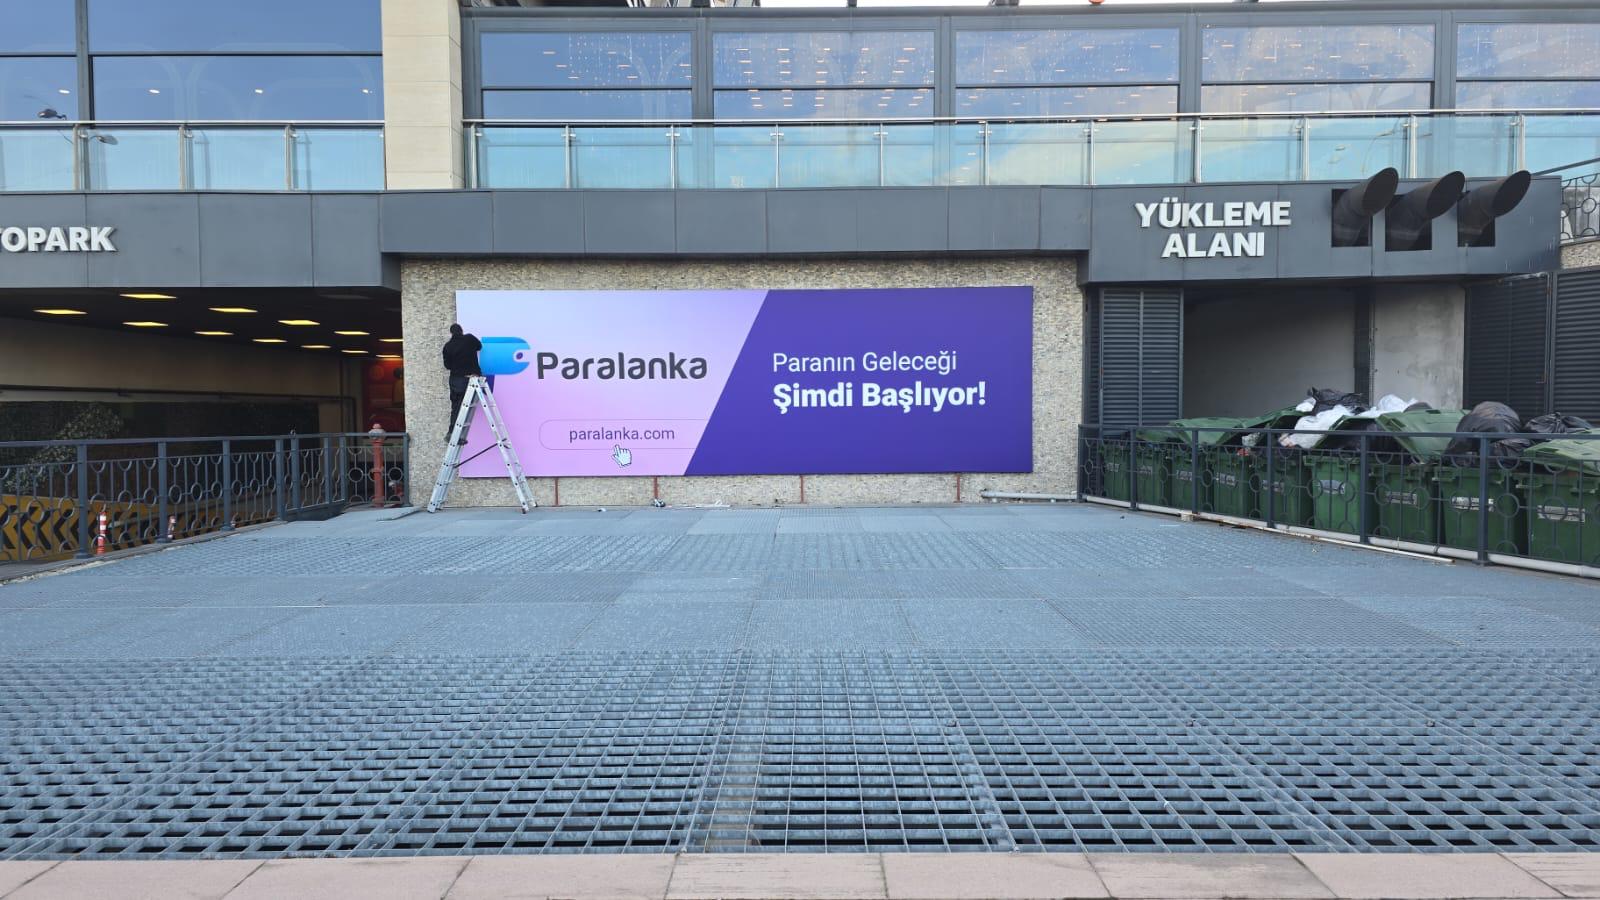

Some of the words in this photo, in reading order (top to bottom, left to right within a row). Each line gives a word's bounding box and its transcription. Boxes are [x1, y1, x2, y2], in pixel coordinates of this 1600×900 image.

[1135, 196, 1292, 228] YÜKLEME
[0, 226, 117, 253] OPARK
[1162, 231, 1265, 258] ALANI
[536, 351, 707, 380] Paralanka
[772, 352, 856, 373] Paranın
[862, 351, 957, 375] Geleceği
[772, 381, 853, 415] Şimdi
[862, 380, 987, 414] Başlıyor!
[569, 427, 675, 443] paralanka.com
